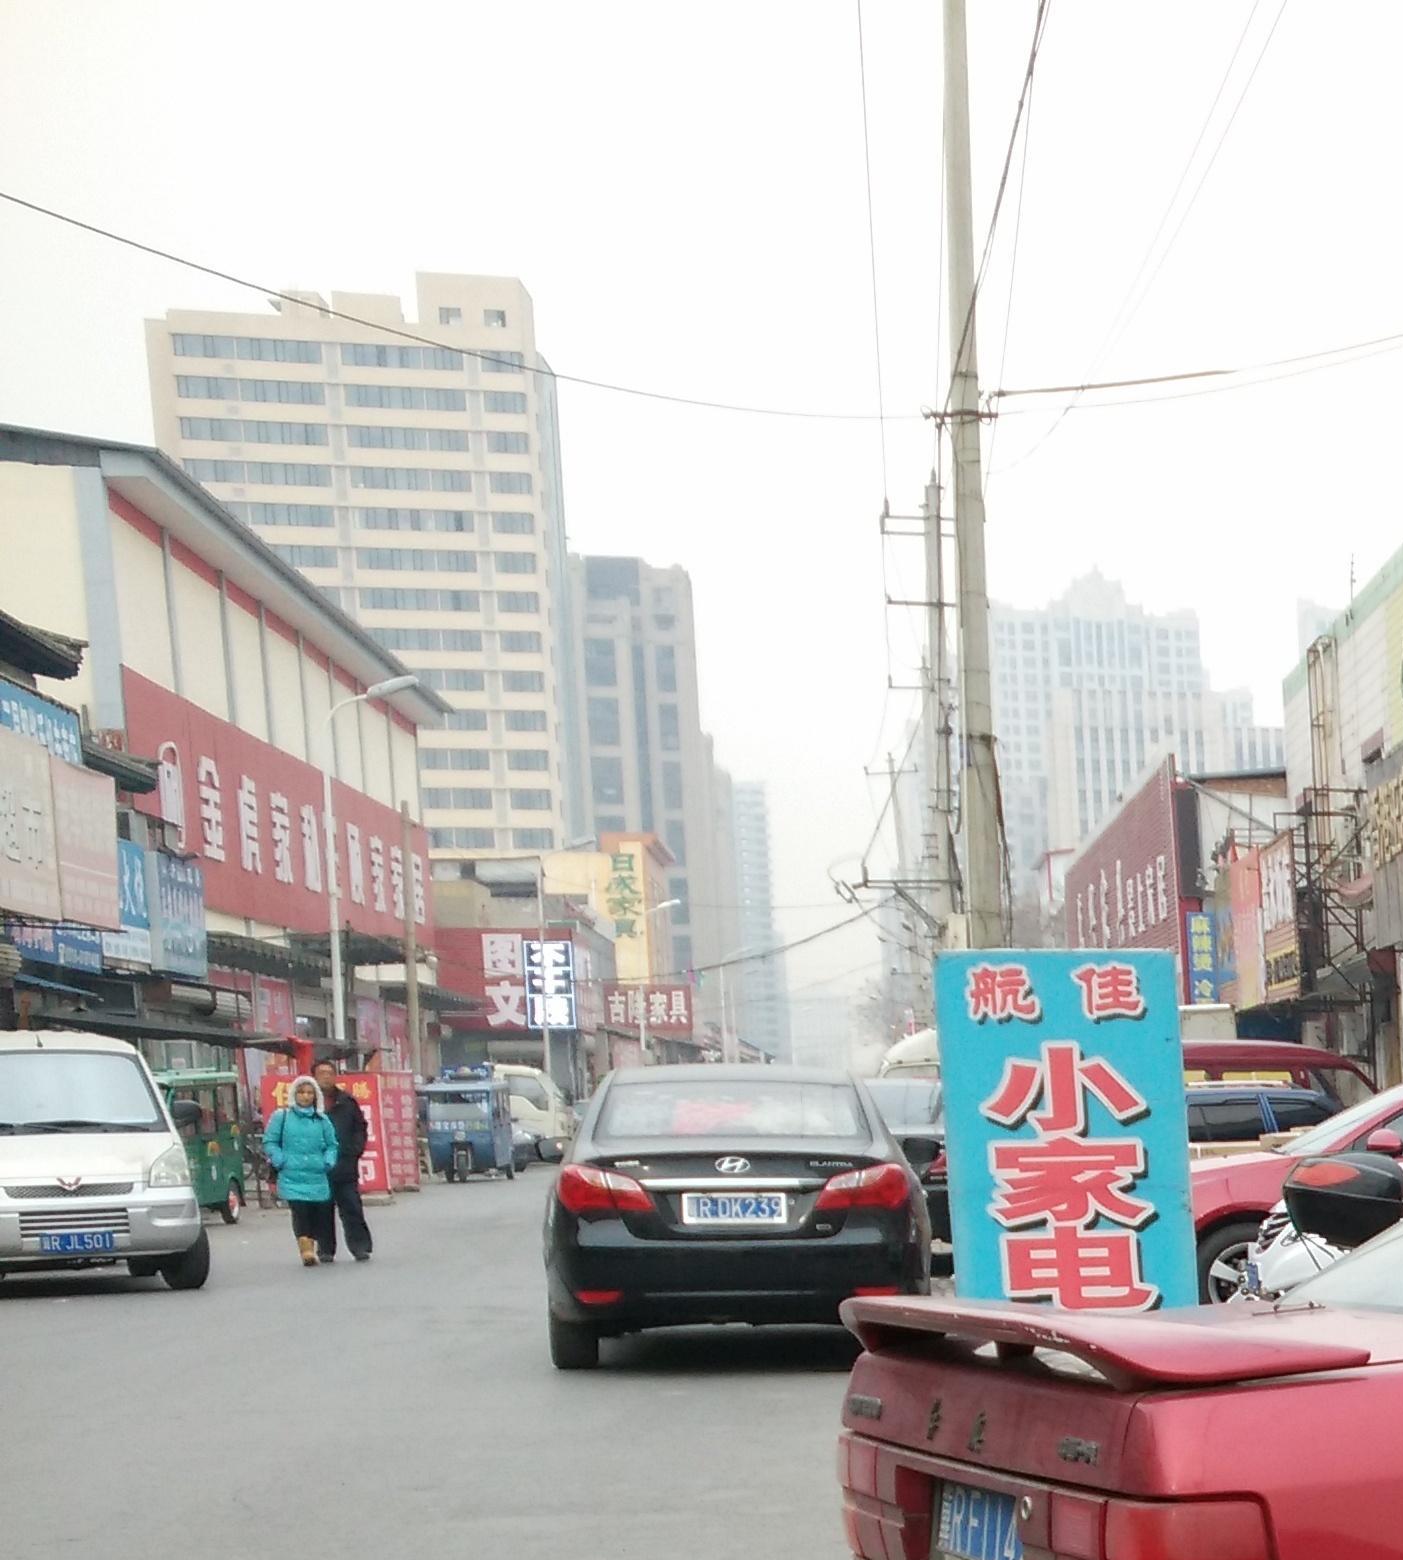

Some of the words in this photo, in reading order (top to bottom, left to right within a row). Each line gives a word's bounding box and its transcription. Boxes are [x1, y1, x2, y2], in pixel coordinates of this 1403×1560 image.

[968, 962, 1145, 1020] 航佳
[979, 1041, 1158, 1311] 小家电
